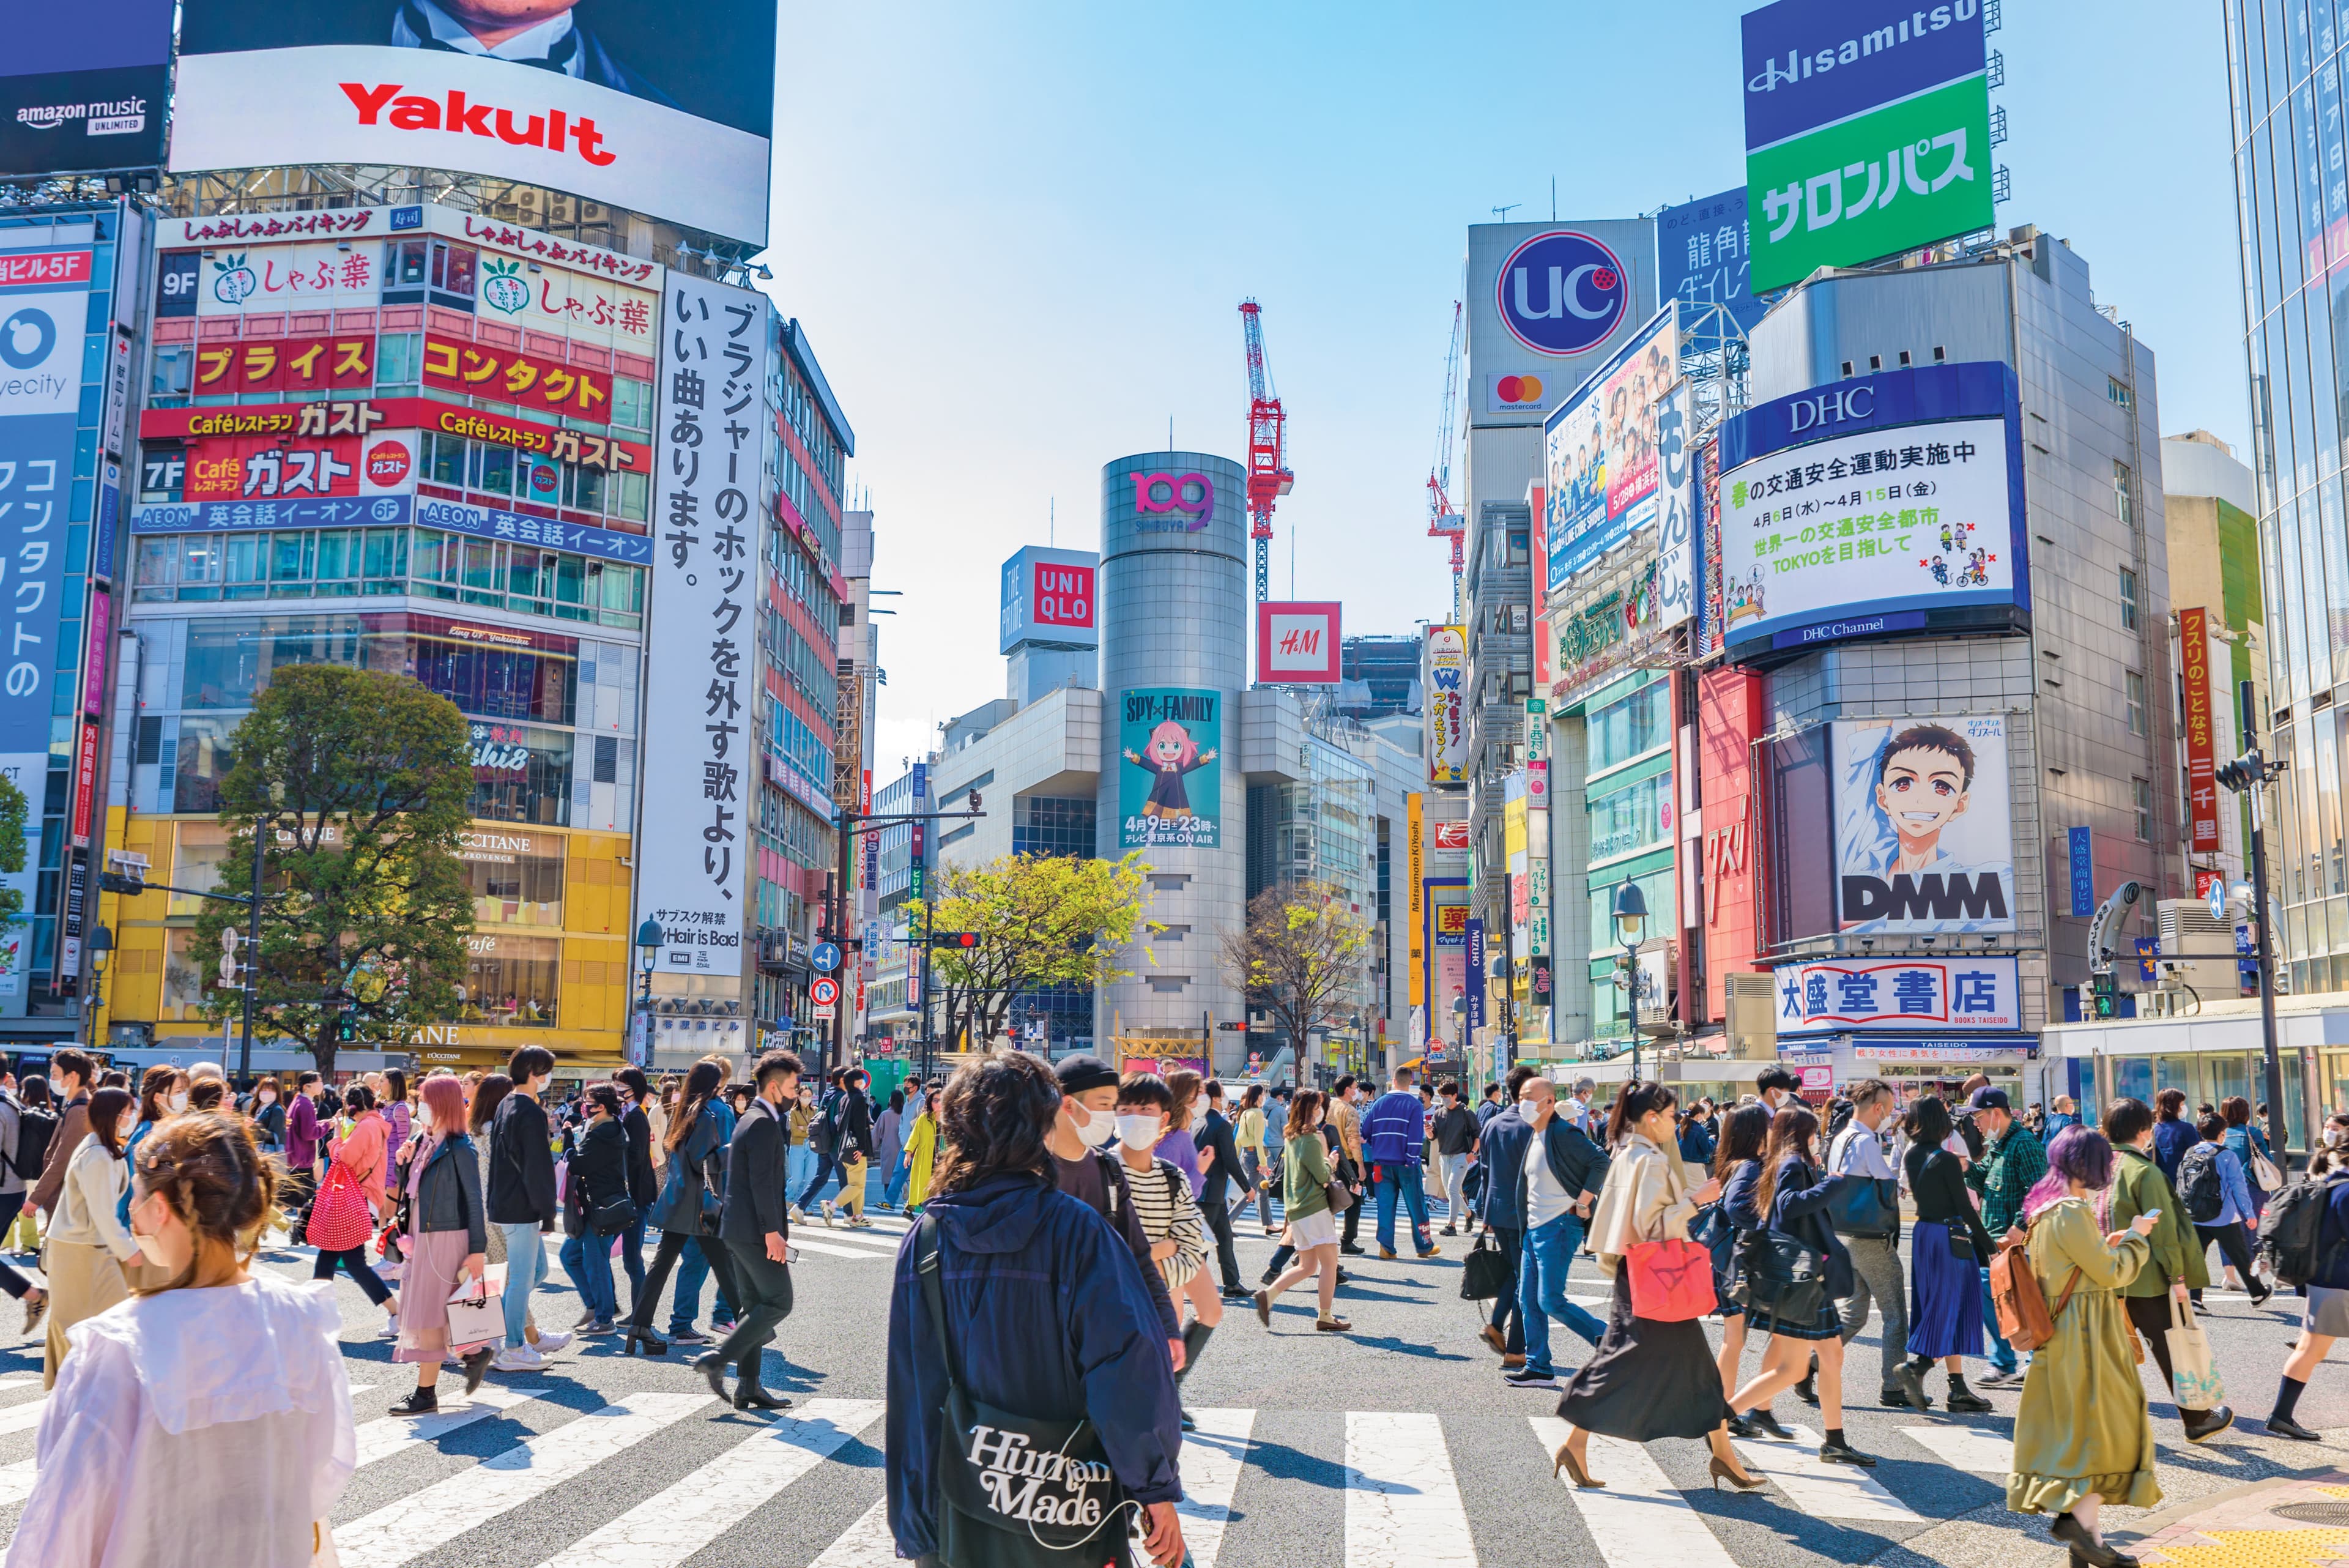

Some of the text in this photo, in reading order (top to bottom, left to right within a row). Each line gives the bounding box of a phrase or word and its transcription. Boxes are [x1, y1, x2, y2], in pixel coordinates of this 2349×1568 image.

[1748, 0, 1977, 92] Hisamitsu
[17, 95, 146, 124] amazon music
[95, 119, 138, 131] UNLIMITED
[338, 83, 616, 166] Yakult
[1762, 127, 1974, 244] サロンパス
[185, 210, 372, 240] しゃぶしゃぶバイキング
[394, 209, 419, 227] 寿司
[464, 216, 654, 282] しゃぶしゃぶバイキング
[163, 272, 196, 295] 9F
[264, 253, 370, 292] しゃぶ葉
[541, 278, 649, 336] しゃぶ葉
[199, 341, 368, 385] プライス
[426, 342, 606, 408] コンタクト
[0, 374, 66, 400] ecity
[298, 401, 385, 437] ガスト
[1789, 385, 1874, 433] DHC
[551, 430, 634, 473] ガスト
[665, 289, 710, 587] いい曲あります。
[146, 462, 184, 488] 7F
[194, 480, 239, 492] レストラン
[195, 458, 240, 480] Café
[243, 449, 351, 497] ガスト
[371, 461, 406, 475] ガスト
[1731, 440, 1975, 510] 春の交通安全運動実施中
[141, 500, 398, 527] AEON 英会話イーオン 6F
[1130, 472, 1214, 531] 109
[1659, 395, 1690, 615] もんじゃ
[428, 503, 648, 559] AEON 英会話イーオン
[1754, 507, 1940, 559] 世界一の交通安全都市
[1773, 535, 1912, 574] TOKYOを目指して
[6, 459, 57, 697] コンタクトの
[1007, 563, 1020, 603] THE
[1042, 571, 1083, 595] UNI
[703, 303, 759, 901] ブラジャーのホックを外す歌より、
[1002, 596, 1023, 641] PRIME
[1041, 596, 1087, 620] QLO
[448, 627, 469, 639] King
[488, 633, 529, 645] Yakiniku
[1279, 628, 1320, 657] H&M
[1803, 618, 1884, 641] DHC Channel
[472, 725, 522, 745] 谷焼肉
[1531, 716, 1542, 751] 渋谷西村
[1968, 727, 2002, 737] ダンスール
[2184, 615, 2216, 841] クスリのことなら 三千里
[470, 742, 529, 771] shi8
[464, 853, 512, 862] PROVENCE
[1126, 833, 1213, 844] テレビ東京系 ON AIR
[866, 853, 877, 891] 調剤薬局
[2075, 833, 2089, 911] 大盛堂商事ビル
[1842, 872, 2008, 921] DMM
[656, 909, 726, 925] サブスク解禁
[1444, 908, 1468, 930] 薬
[667, 927, 739, 947] Hair is Bad
[1411, 949, 1421, 958] 薬
[2090, 904, 2108, 970] 渋谷センター街
[1471, 995, 1479, 1032] みずほ銀
[1782, 971, 1996, 1018] 大盛堂書店
[664, 1020, 740, 1031] 谷駅前ビル
[967, 1424, 1111, 1493] Human
[979, 1470, 1101, 1526] Made
